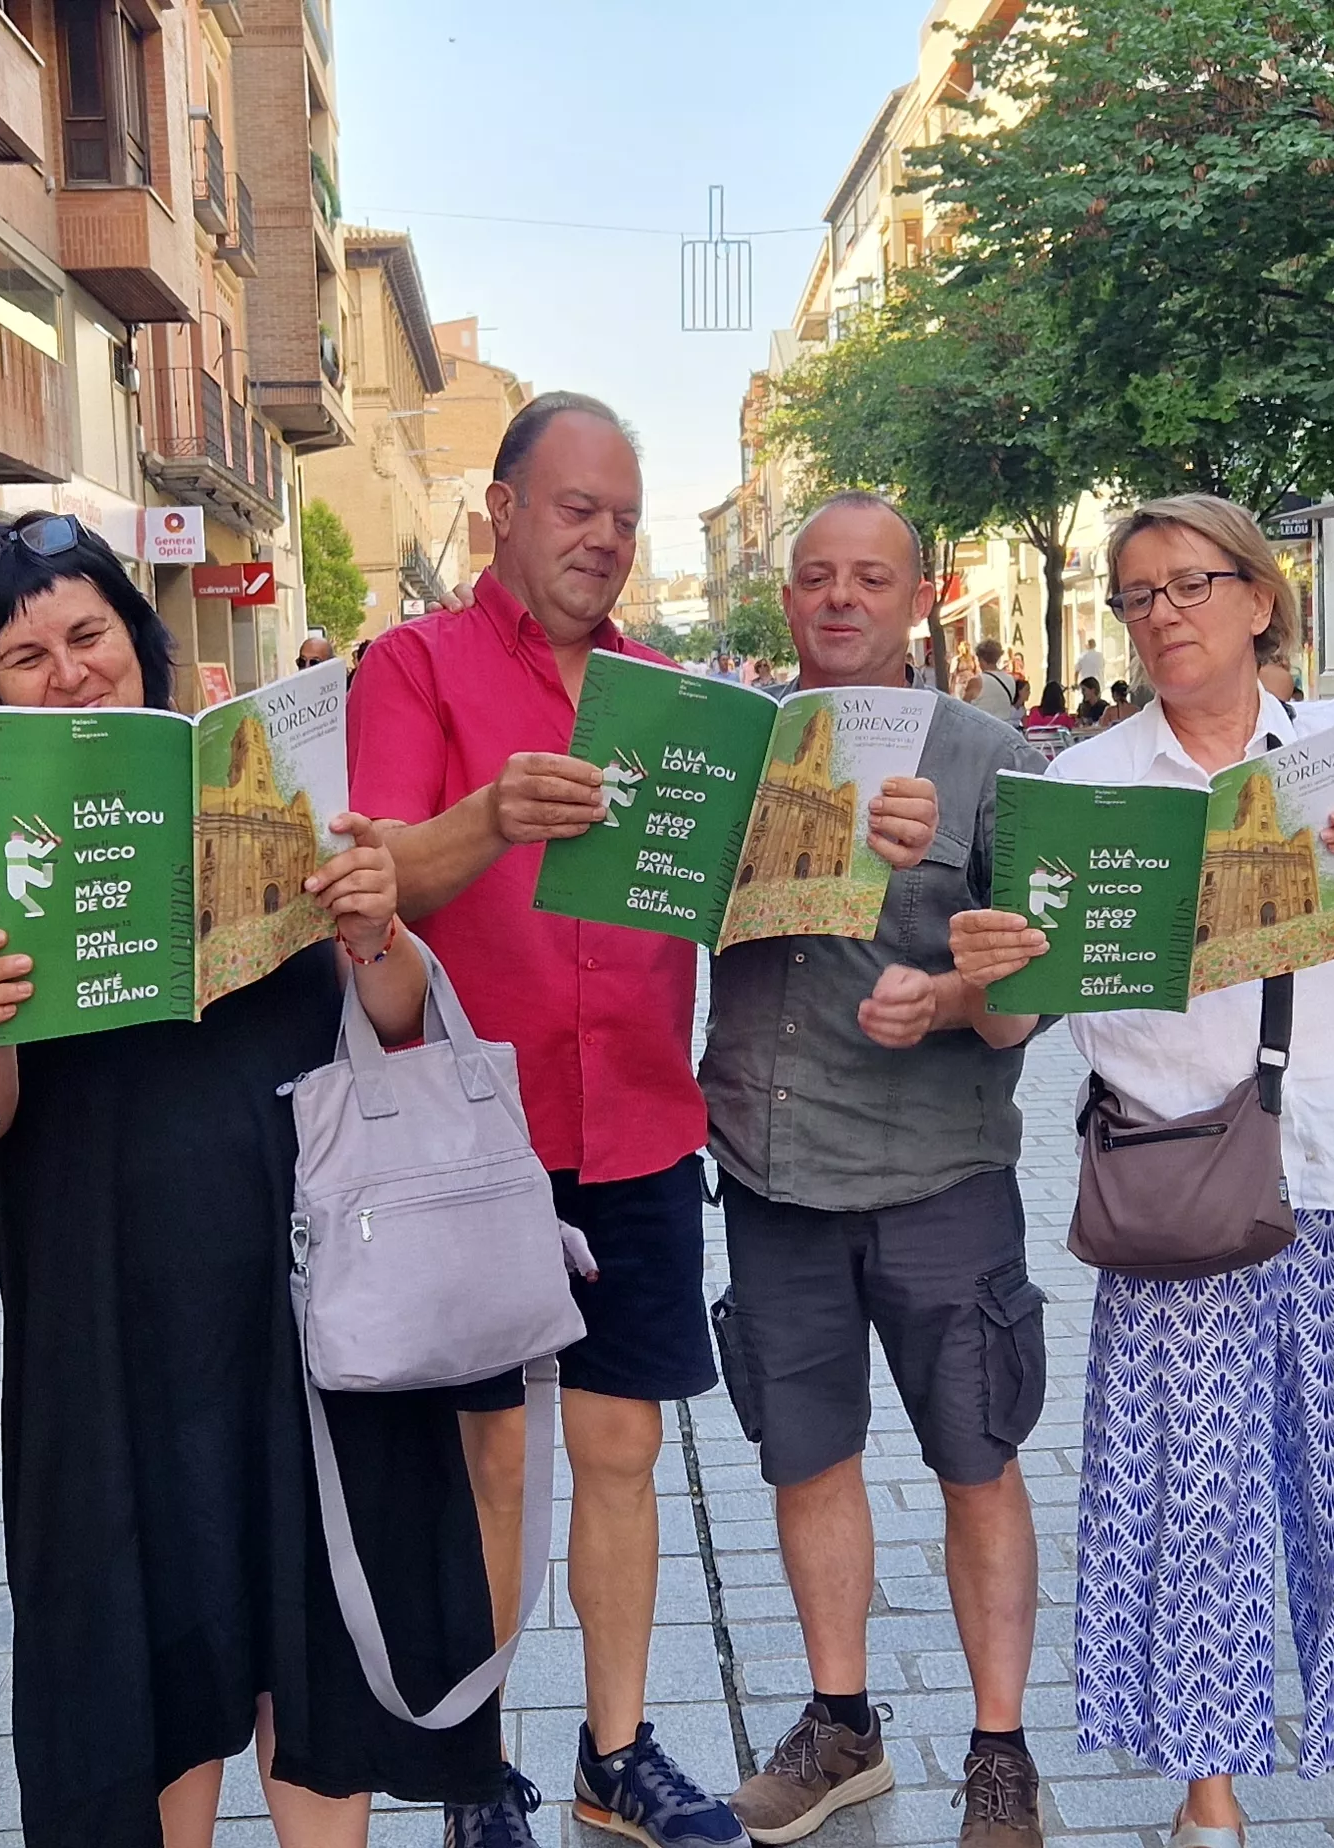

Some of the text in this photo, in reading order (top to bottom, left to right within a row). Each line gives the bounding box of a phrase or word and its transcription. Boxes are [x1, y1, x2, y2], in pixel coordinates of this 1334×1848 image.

[155, 536, 196, 546] General
[158, 546, 193, 557] Optica
[199, 585, 241, 595] culinarium
[319, 681, 338, 696] 2025
[267, 690, 296, 717] SAN
[841, 698, 874, 714] SAN
[900, 706, 922, 716] 2025
[269, 696, 338, 739] LORENZO
[837, 716, 919, 733] LORENZO
[664, 745, 706, 763] LA LA
[1277, 747, 1310, 771] SAN
[662, 758, 736, 782] LOVE YOU
[655, 785, 706, 803] VICCO
[74, 797, 125, 815] LA LA
[74, 811, 164, 829] LOVE YOU
[648, 813, 696, 829] MÄGO
[645, 824, 690, 840] DE OZ
[73, 846, 136, 864] VICCO
[638, 850, 673, 864] DON
[1090, 849, 1136, 859] LA LA
[635, 861, 705, 883] PATRICIO
[1089, 859, 1170, 869] LOVE YOU
[75, 880, 131, 899] MÄGO
[629, 887, 669, 903] CAFÉ
[1087, 884, 1142, 894] VICCO
[75, 894, 127, 914] DE OZ
[627, 897, 696, 920] QUIJANO
[1085, 907, 1137, 919] MÄGO
[1085, 918, 1132, 929] DE OZ
[76, 930, 116, 947] DON
[76, 938, 158, 961] PATRICIO
[1083, 943, 1120, 954] DON
[1083, 951, 1156, 963] PATRICIO
[76, 972, 123, 995] CAFÉ
[1081, 974, 1122, 987] CAFÉ
[76, 984, 159, 1009] QUIJANO
[1080, 984, 1154, 996] QUIJANO
